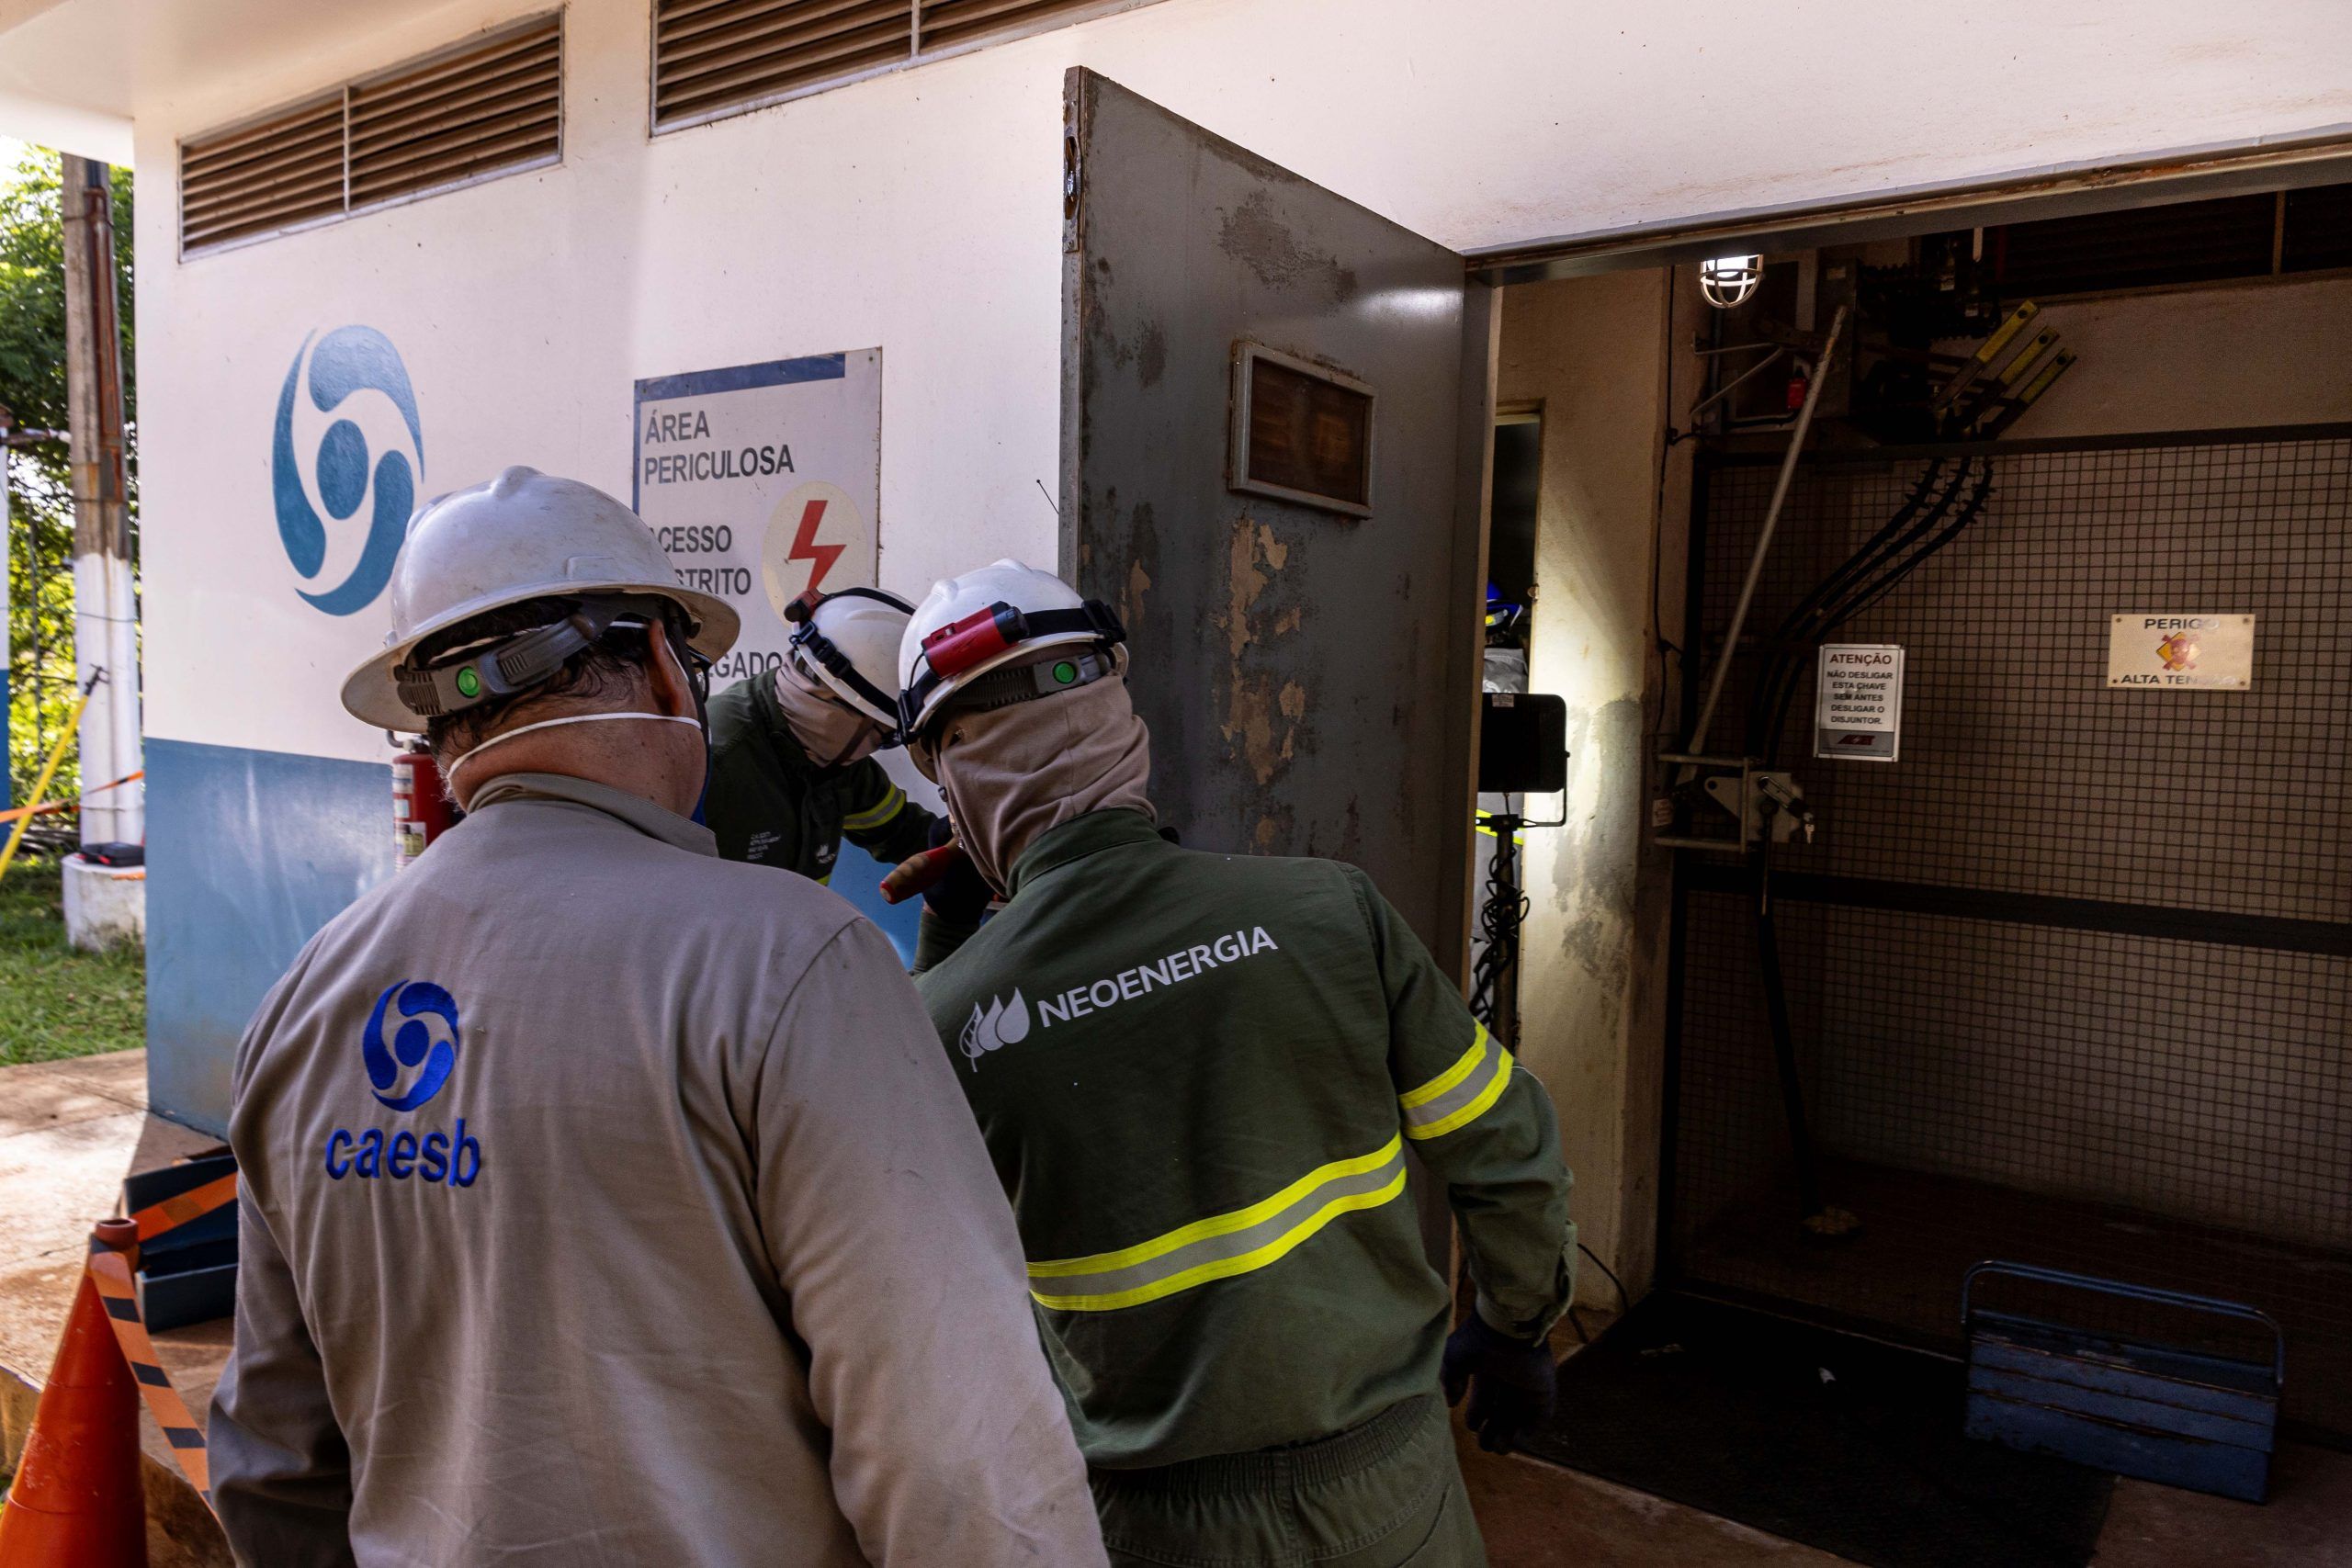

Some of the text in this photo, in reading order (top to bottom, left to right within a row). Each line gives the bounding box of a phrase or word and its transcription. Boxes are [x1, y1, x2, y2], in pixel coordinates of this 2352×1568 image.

[645, 410, 710, 445] ÁREA
[645, 445, 795, 485] PERICULOSA
[650, 525, 732, 553] CESSO
[674, 567, 752, 595] TRITO
[708, 651, 783, 678] GADO
[1829, 653, 1893, 667] ATENÇÃO
[1826, 670, 1894, 680] NÃO DESLIGAR
[1832, 682, 1886, 691] ESTA CHAVE
[2120, 674, 2161, 684] ALTA
[1830, 704, 1885, 714] DESLIGAR O
[1833, 693, 1883, 702] SEM ANTES
[1036, 926, 1279, 1028] NEOENERGIA
[325, 1118, 481, 1188] caesb
